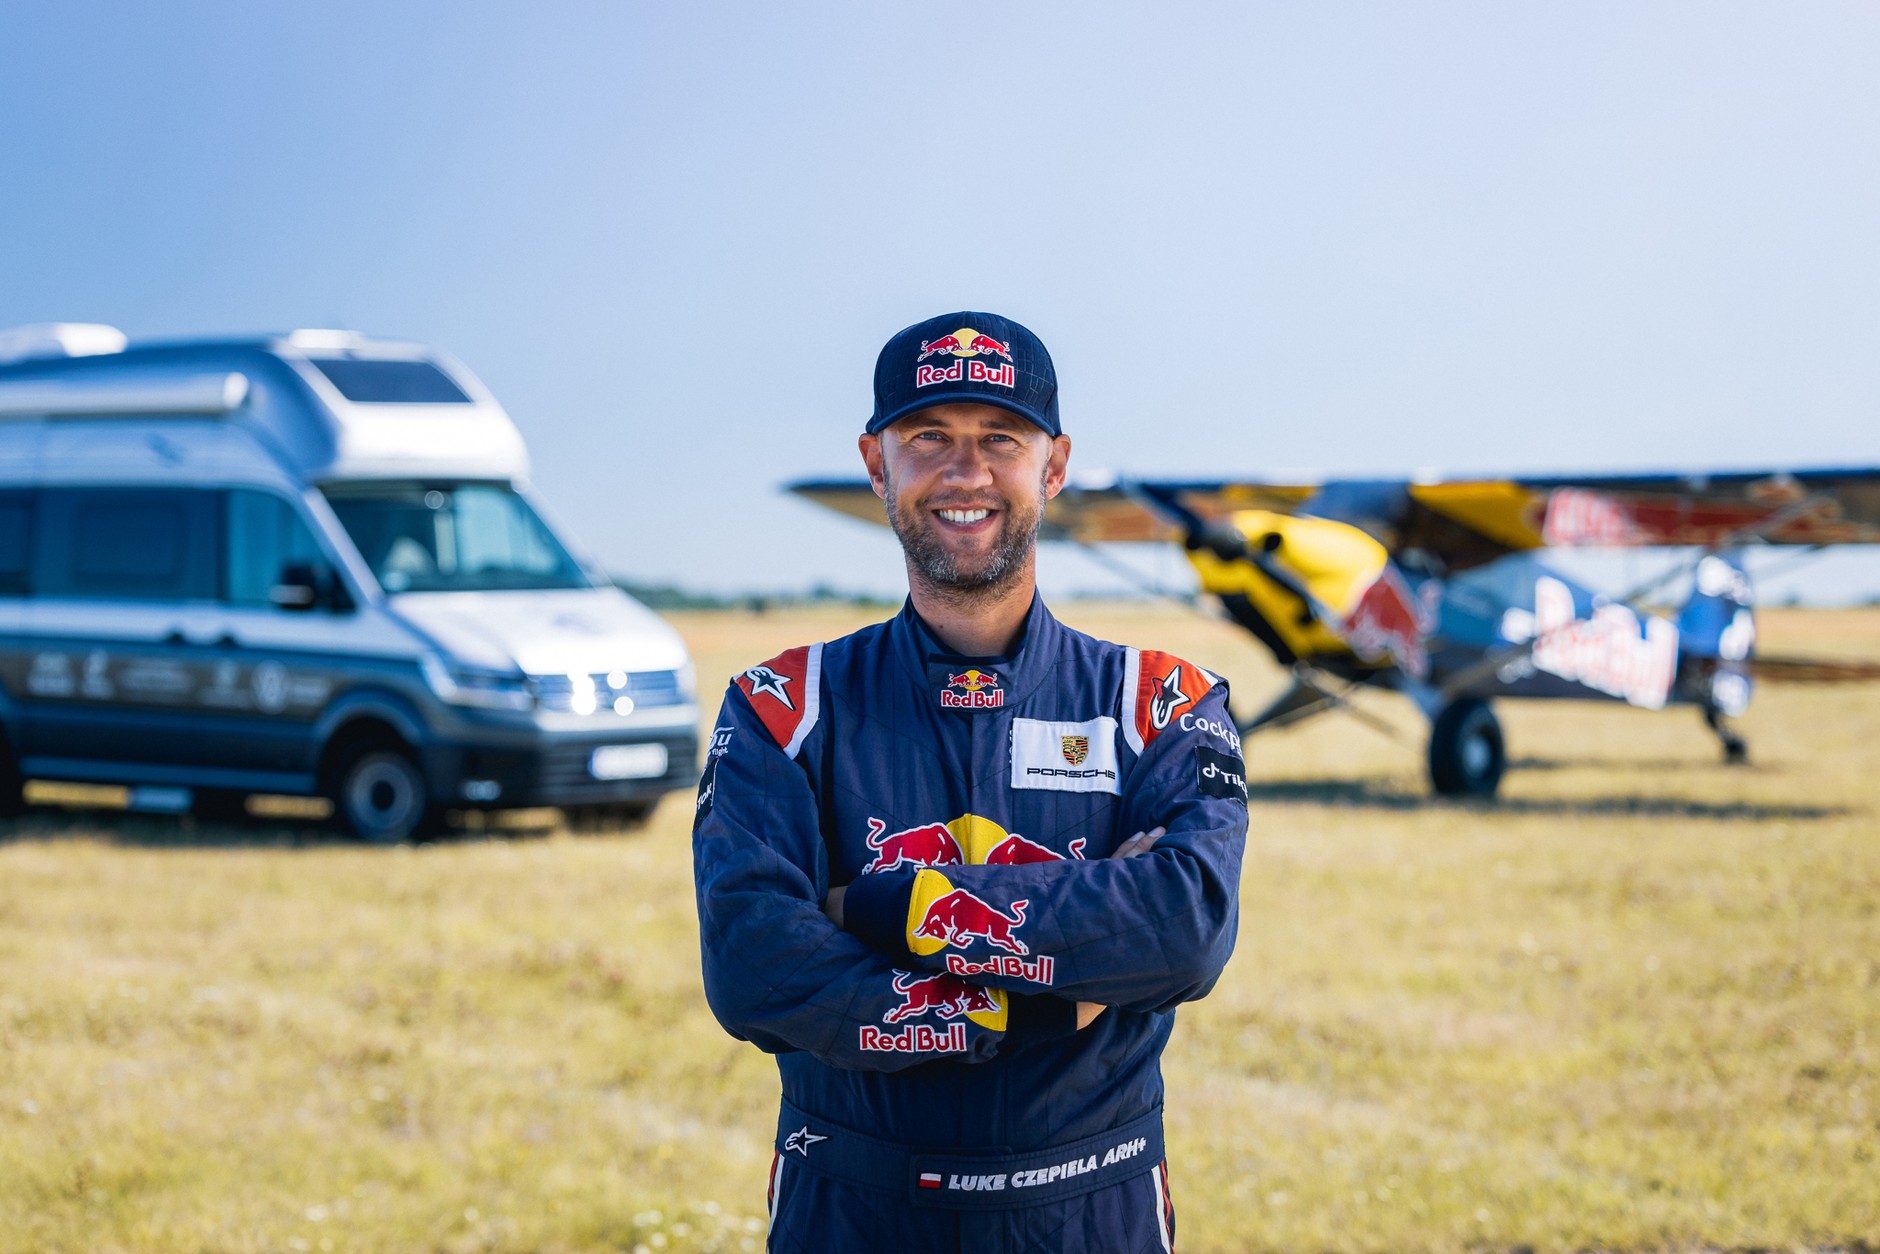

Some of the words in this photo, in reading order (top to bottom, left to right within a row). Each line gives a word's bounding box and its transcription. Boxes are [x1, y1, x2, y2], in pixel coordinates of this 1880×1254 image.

[917, 359, 963, 388] Red
[968, 360, 1014, 388] Bull
[941, 690, 972, 708] Red
[973, 689, 1004, 708] Bull
[1027, 768, 1116, 780] PORSCHE
[946, 954, 1002, 976] Red
[1002, 955, 1054, 985] Bull
[860, 1025, 914, 1052] Red
[915, 1023, 966, 1052] Bull
[948, 1174, 1007, 1191] LUKE
[1011, 1154, 1097, 1188] CZEPIELA
